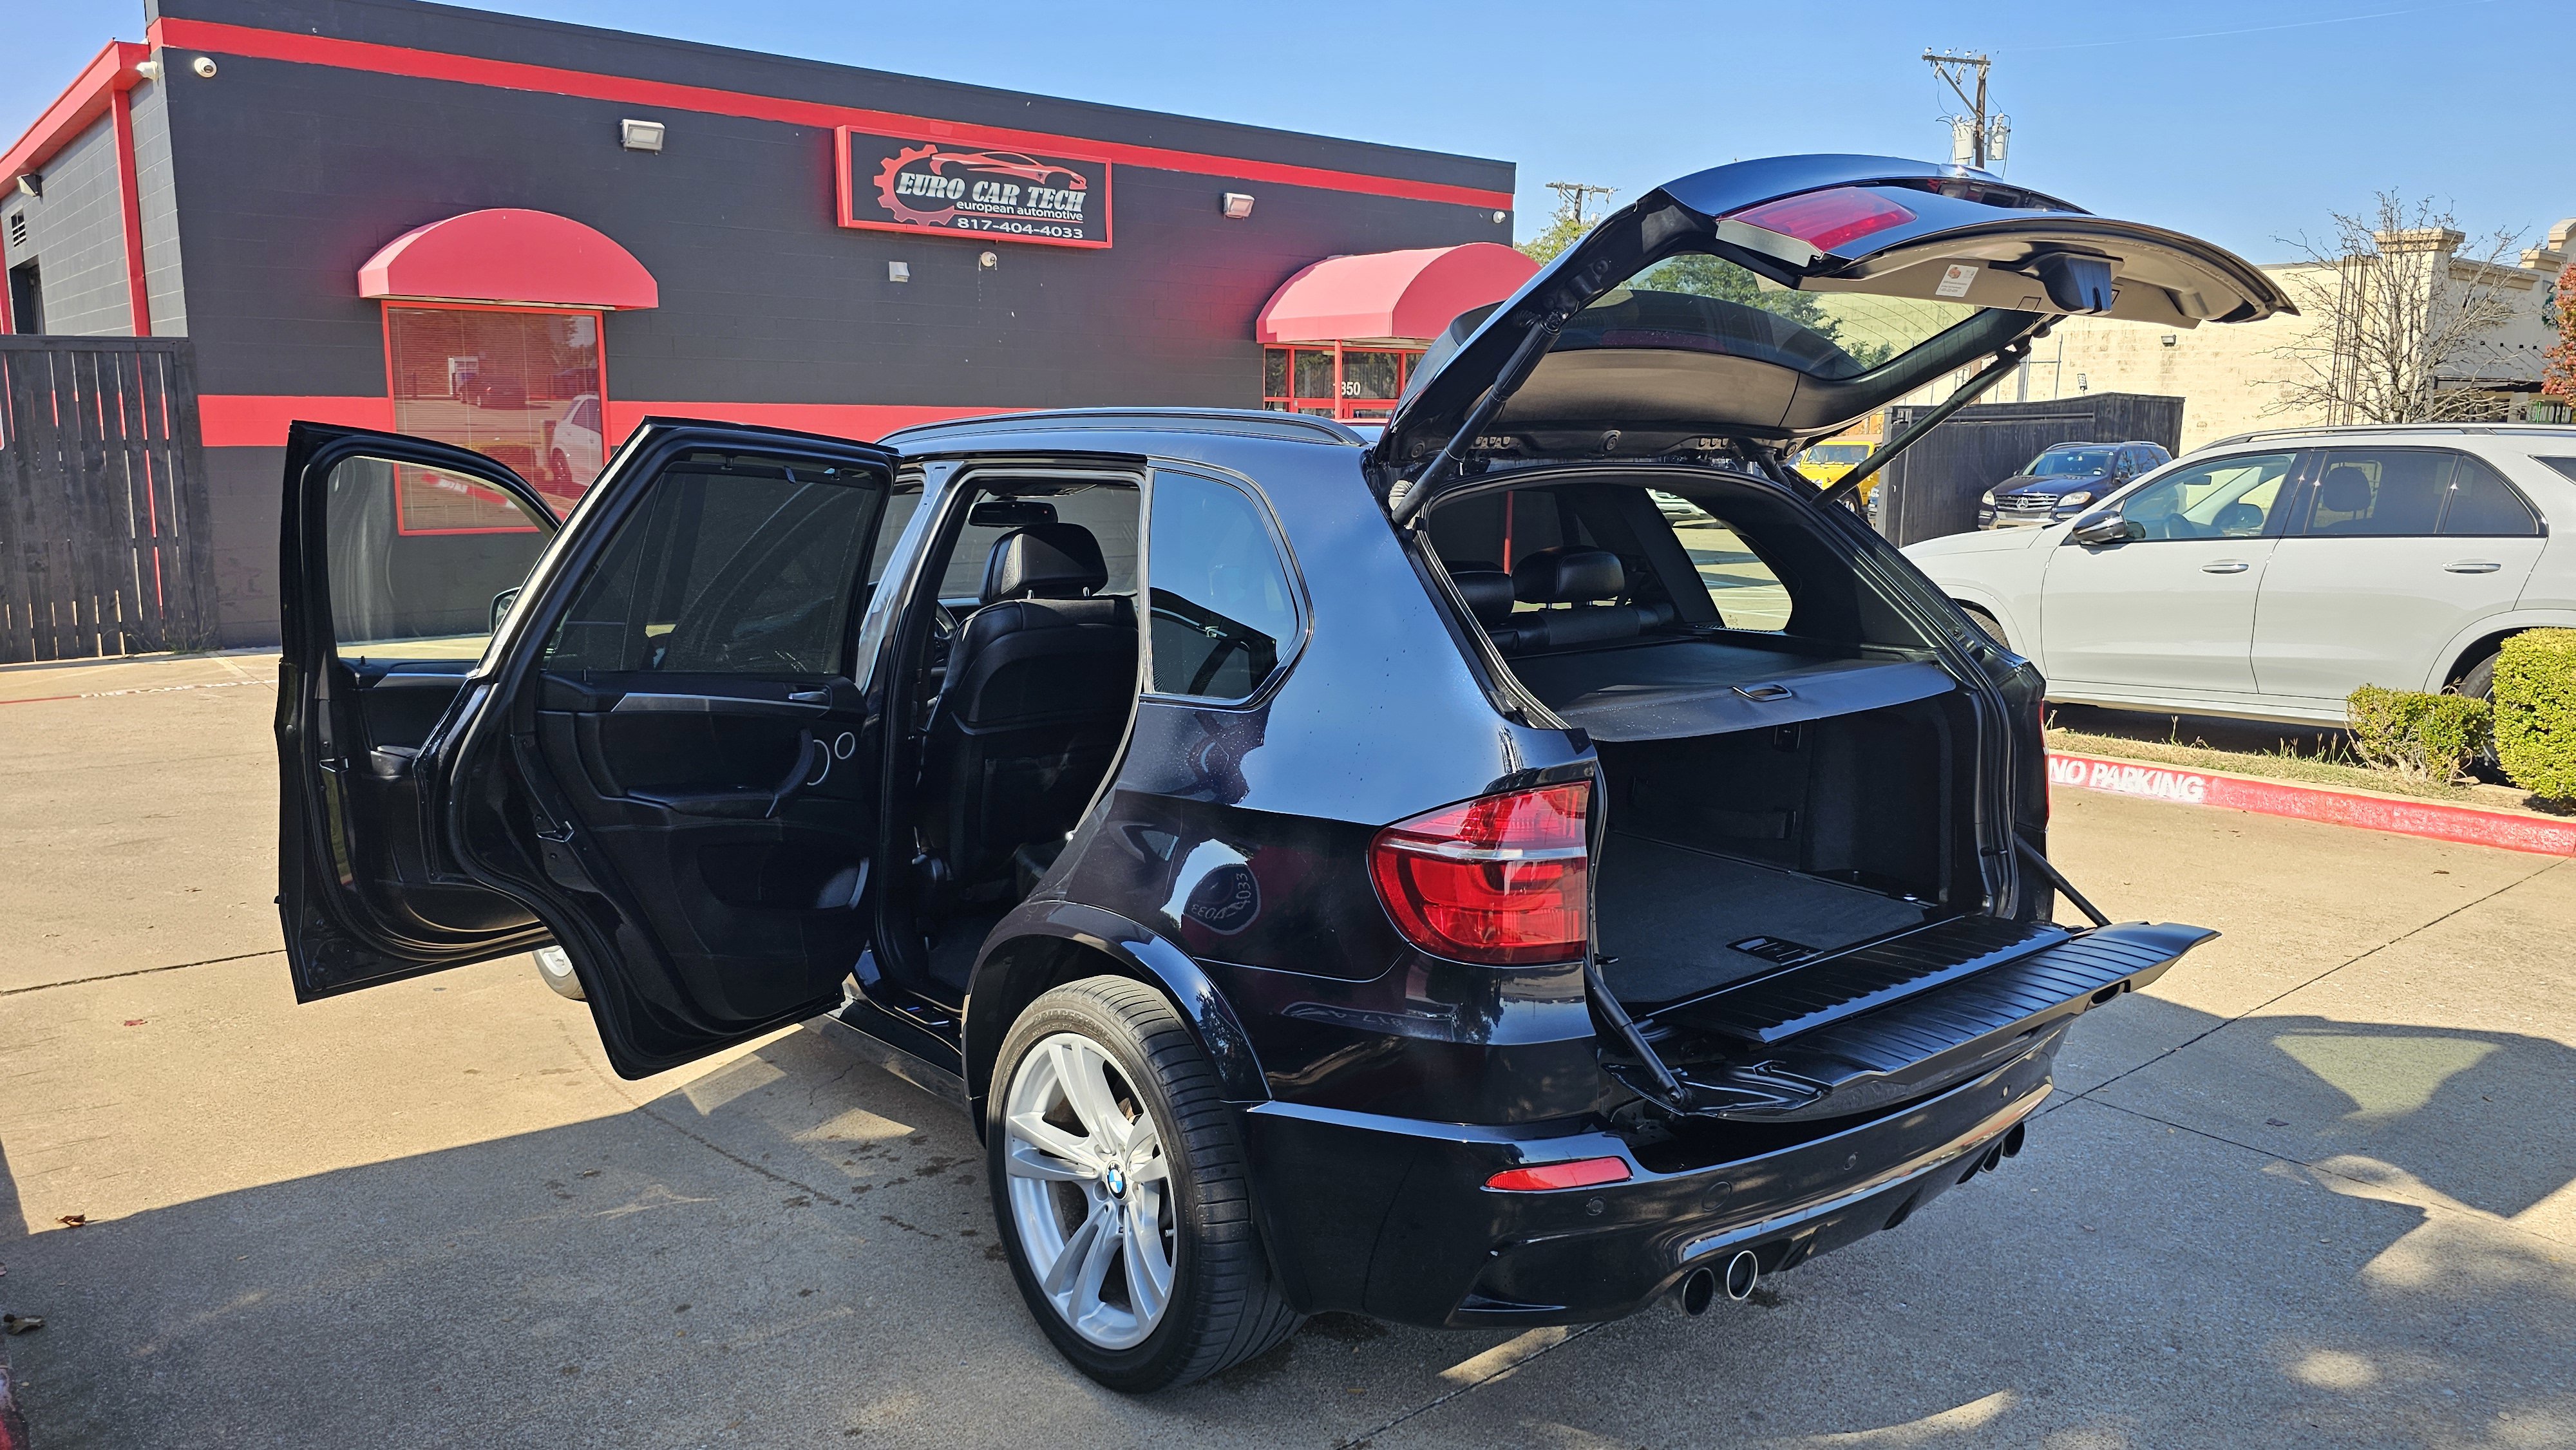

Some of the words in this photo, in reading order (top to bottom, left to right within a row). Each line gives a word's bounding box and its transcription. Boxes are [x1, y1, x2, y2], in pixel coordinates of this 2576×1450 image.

[896, 172, 965, 200] EURO
[972, 180, 1021, 205] CAR
[1027, 186, 1086, 212] TECH
[956, 200, 1014, 214] european
[1017, 207, 1084, 221] automotive
[957, 218, 1084, 239] 817-404-4033
[1333, 381, 1361, 396] 850
[2548, 406, 2571, 422] OPEN
[2049, 757, 2087, 784] NO
[2089, 762, 2204, 804] PARKING
